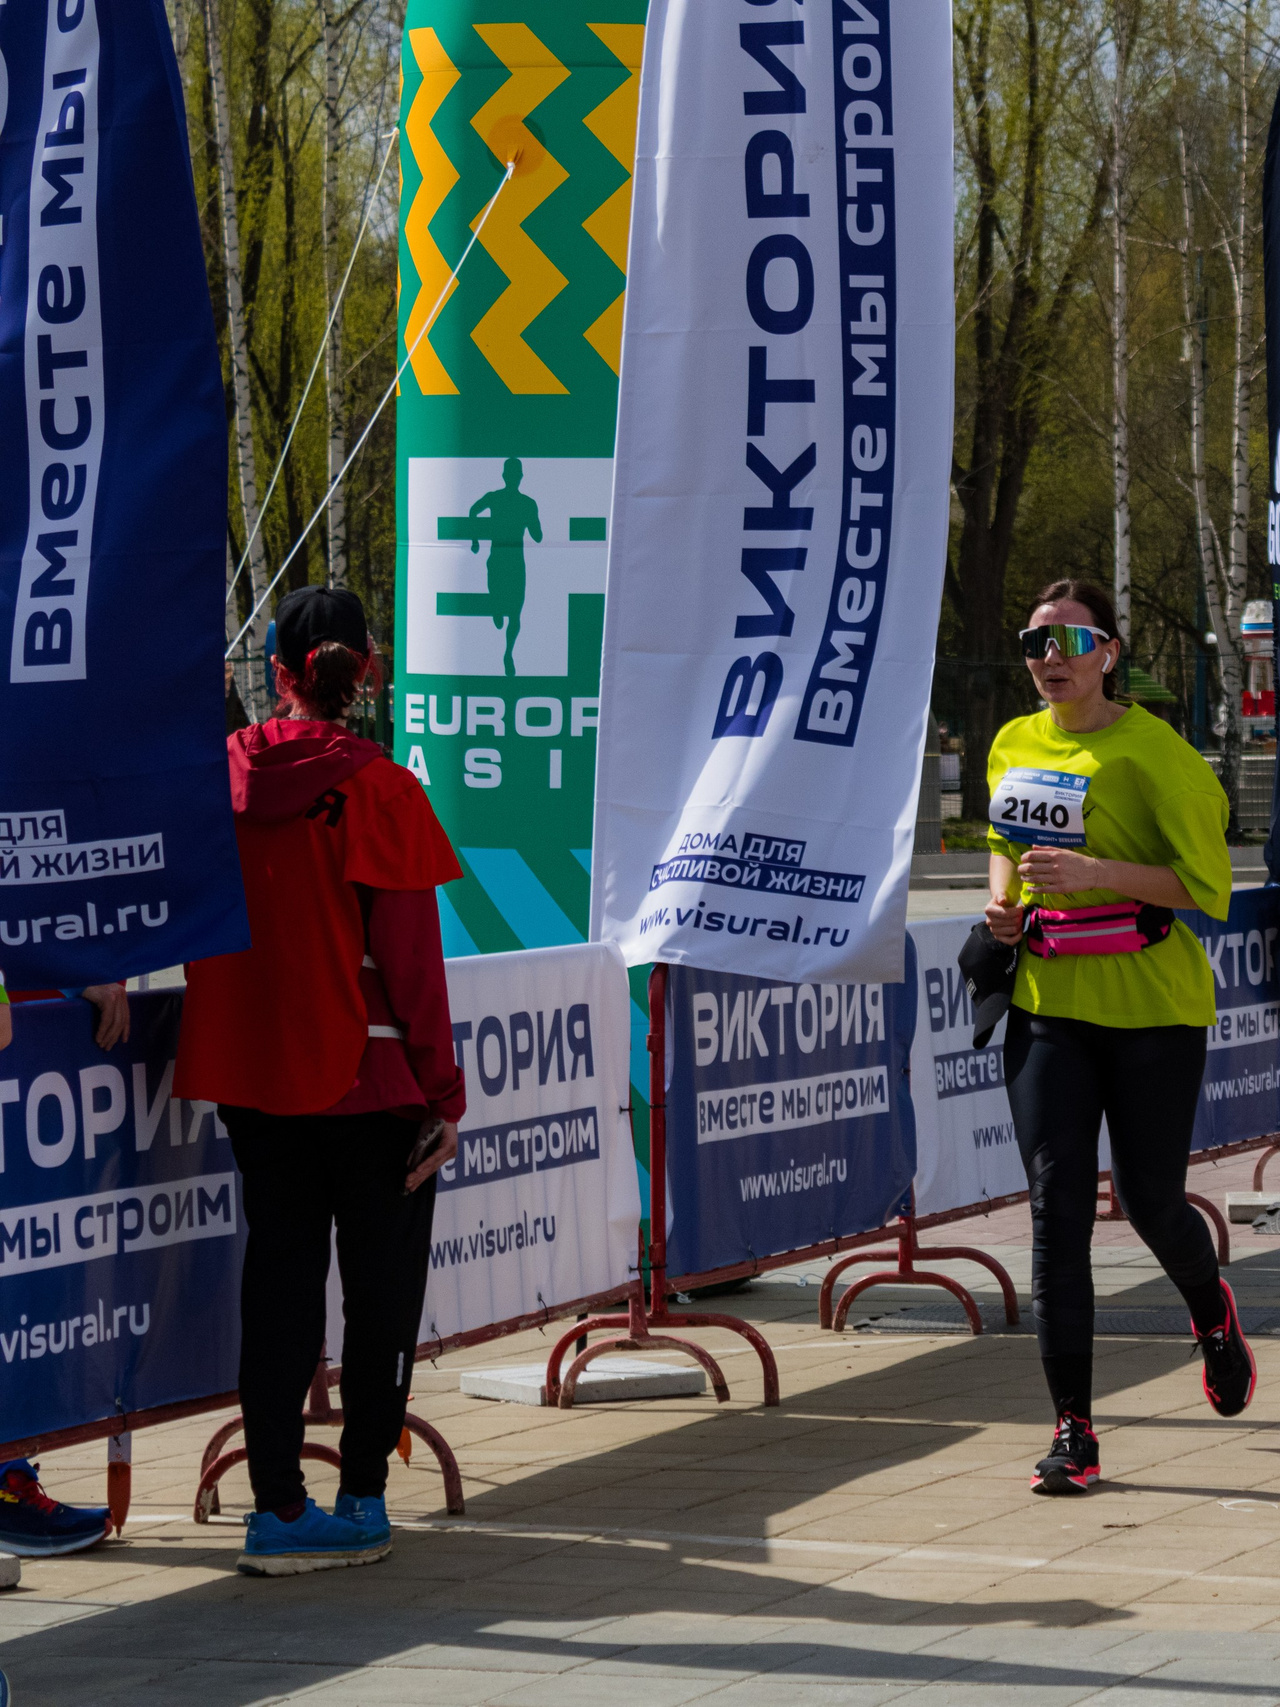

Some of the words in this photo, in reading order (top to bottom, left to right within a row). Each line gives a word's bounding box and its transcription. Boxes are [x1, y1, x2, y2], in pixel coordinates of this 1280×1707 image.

[40, 68, 88, 228] мы
[849, 274, 887, 397] мы
[712, 0, 817, 740] ВИКТОРИ
[0, 815, 63, 845] ДЛЯ
[1001, 796, 1069, 829] 2140
[30, 841, 161, 879] ЖИЗНИ
[678, 832, 738, 854] ДОМА
[743, 837, 804, 864] ДЛЯ
[651, 860, 762, 889] СЧАСТЛИВОЙ
[767, 869, 865, 900] ЖИЗНИ
[0, 901, 169, 946] ural.ru
[639, 901, 850, 948] www.visural.ru
[693, 983, 885, 1067] ВИКТОРИЯ
[1237, 1011, 1260, 1038] мы
[781, 1085, 811, 1122] мы
[815, 1073, 885, 1121] строим
[463, 1135, 502, 1177] мы
[506, 1115, 596, 1173] строим
[740, 1153, 847, 1202] www.visural.ru
[0, 1212, 61, 1263] мы
[74, 1183, 231, 1254] строим
